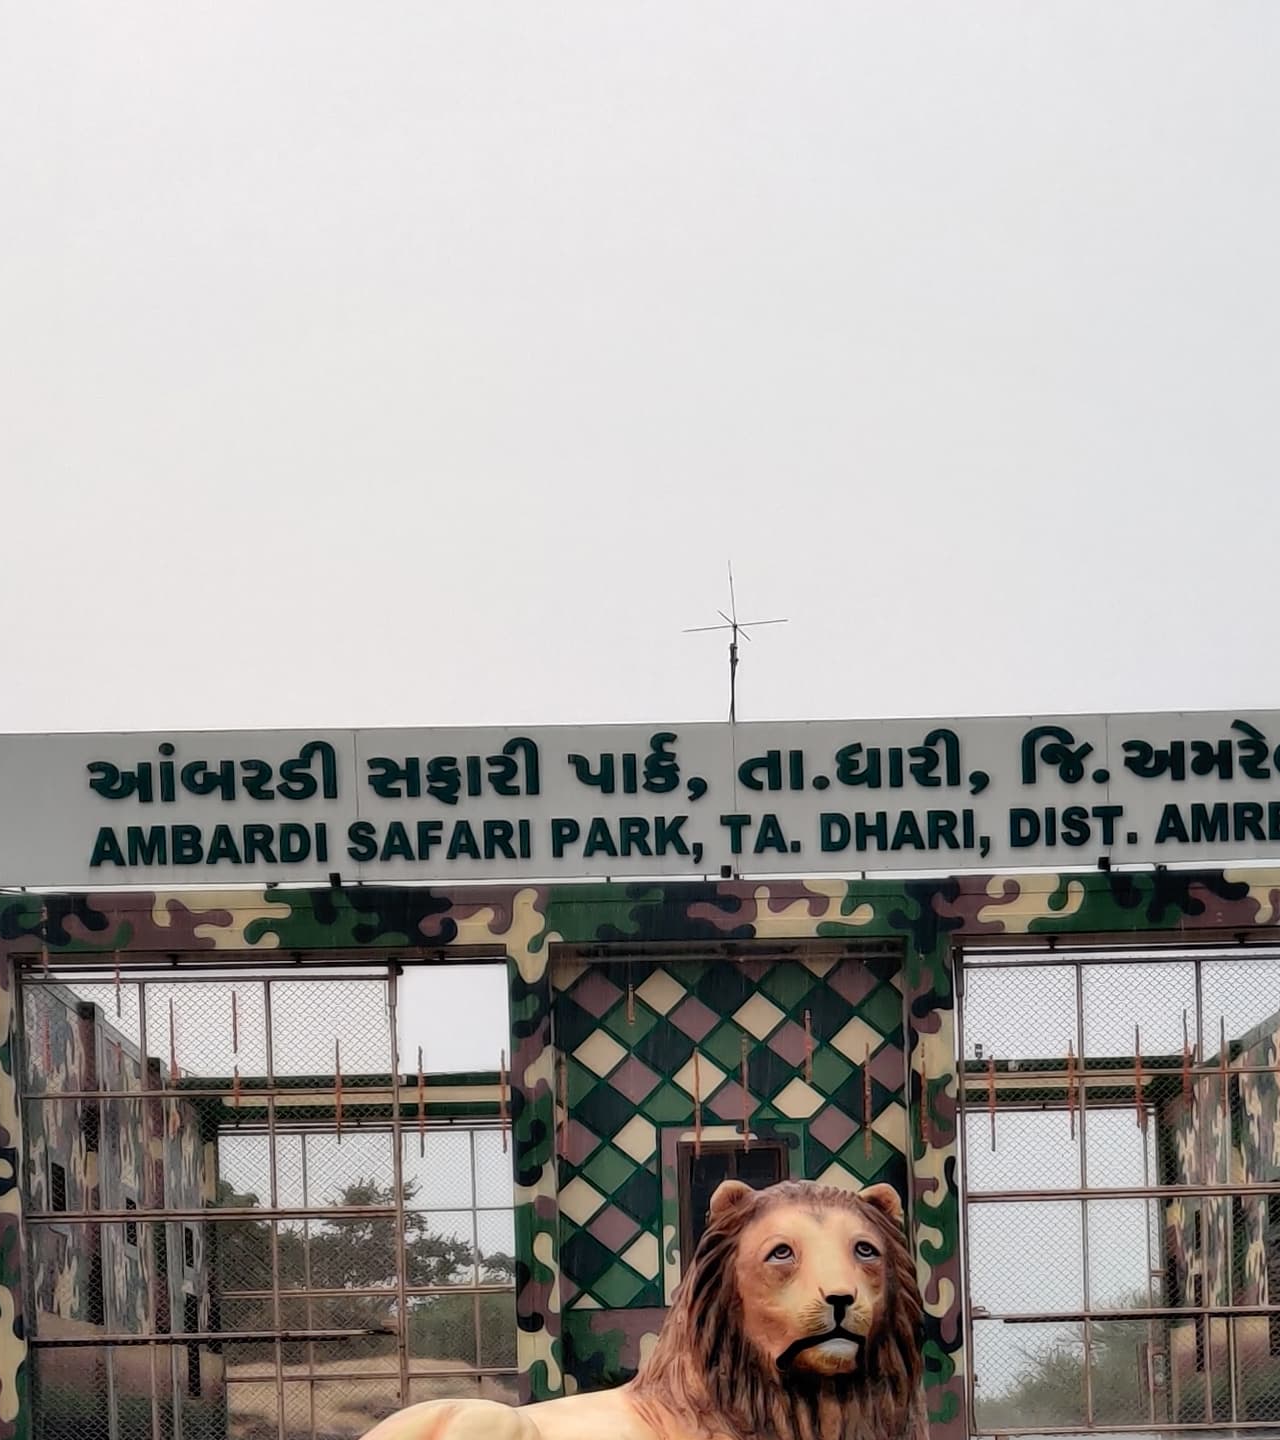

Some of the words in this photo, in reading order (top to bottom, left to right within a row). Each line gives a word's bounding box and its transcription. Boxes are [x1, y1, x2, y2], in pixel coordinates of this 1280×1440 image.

[86, 741, 339, 805] આંબરડી
[366, 736, 541, 807] સફારી
[567, 731, 710, 803] પાર્ક,
[89, 821, 329, 869] AMBARDI
[346, 818, 532, 864] SAFARI
[550, 814, 704, 865] PARK,
[719, 812, 802, 855] TA.
[819, 808, 991, 859] DHARI,
[1009, 803, 1139, 849] DIST.
